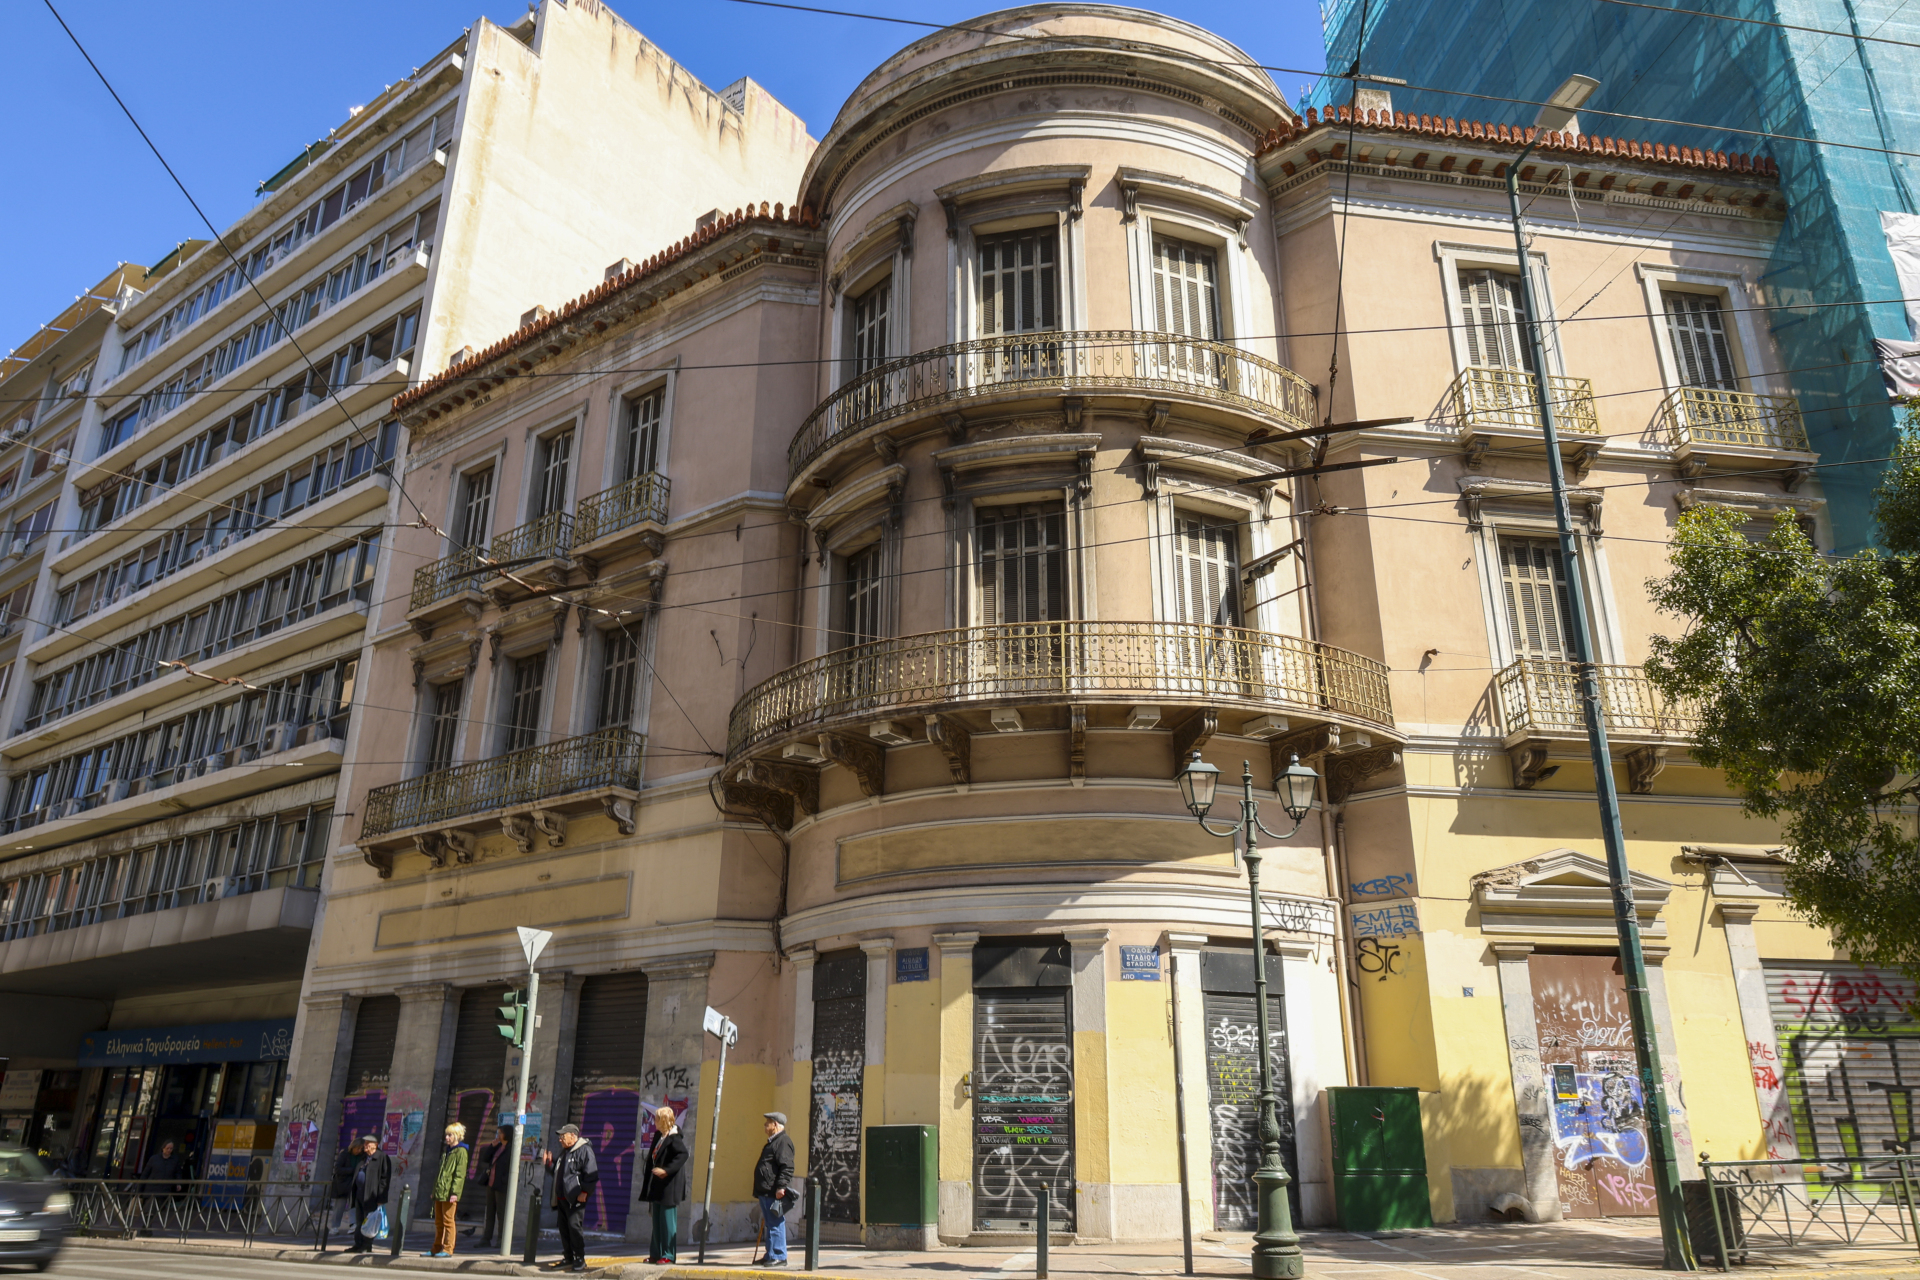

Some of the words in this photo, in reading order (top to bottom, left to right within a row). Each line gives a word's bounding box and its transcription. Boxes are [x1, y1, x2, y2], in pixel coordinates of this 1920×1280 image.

[106, 1037, 143, 1058] Ελληνικά
[202, 1038, 228, 1050] Hellenic
[228, 1037, 243, 1048] Post
